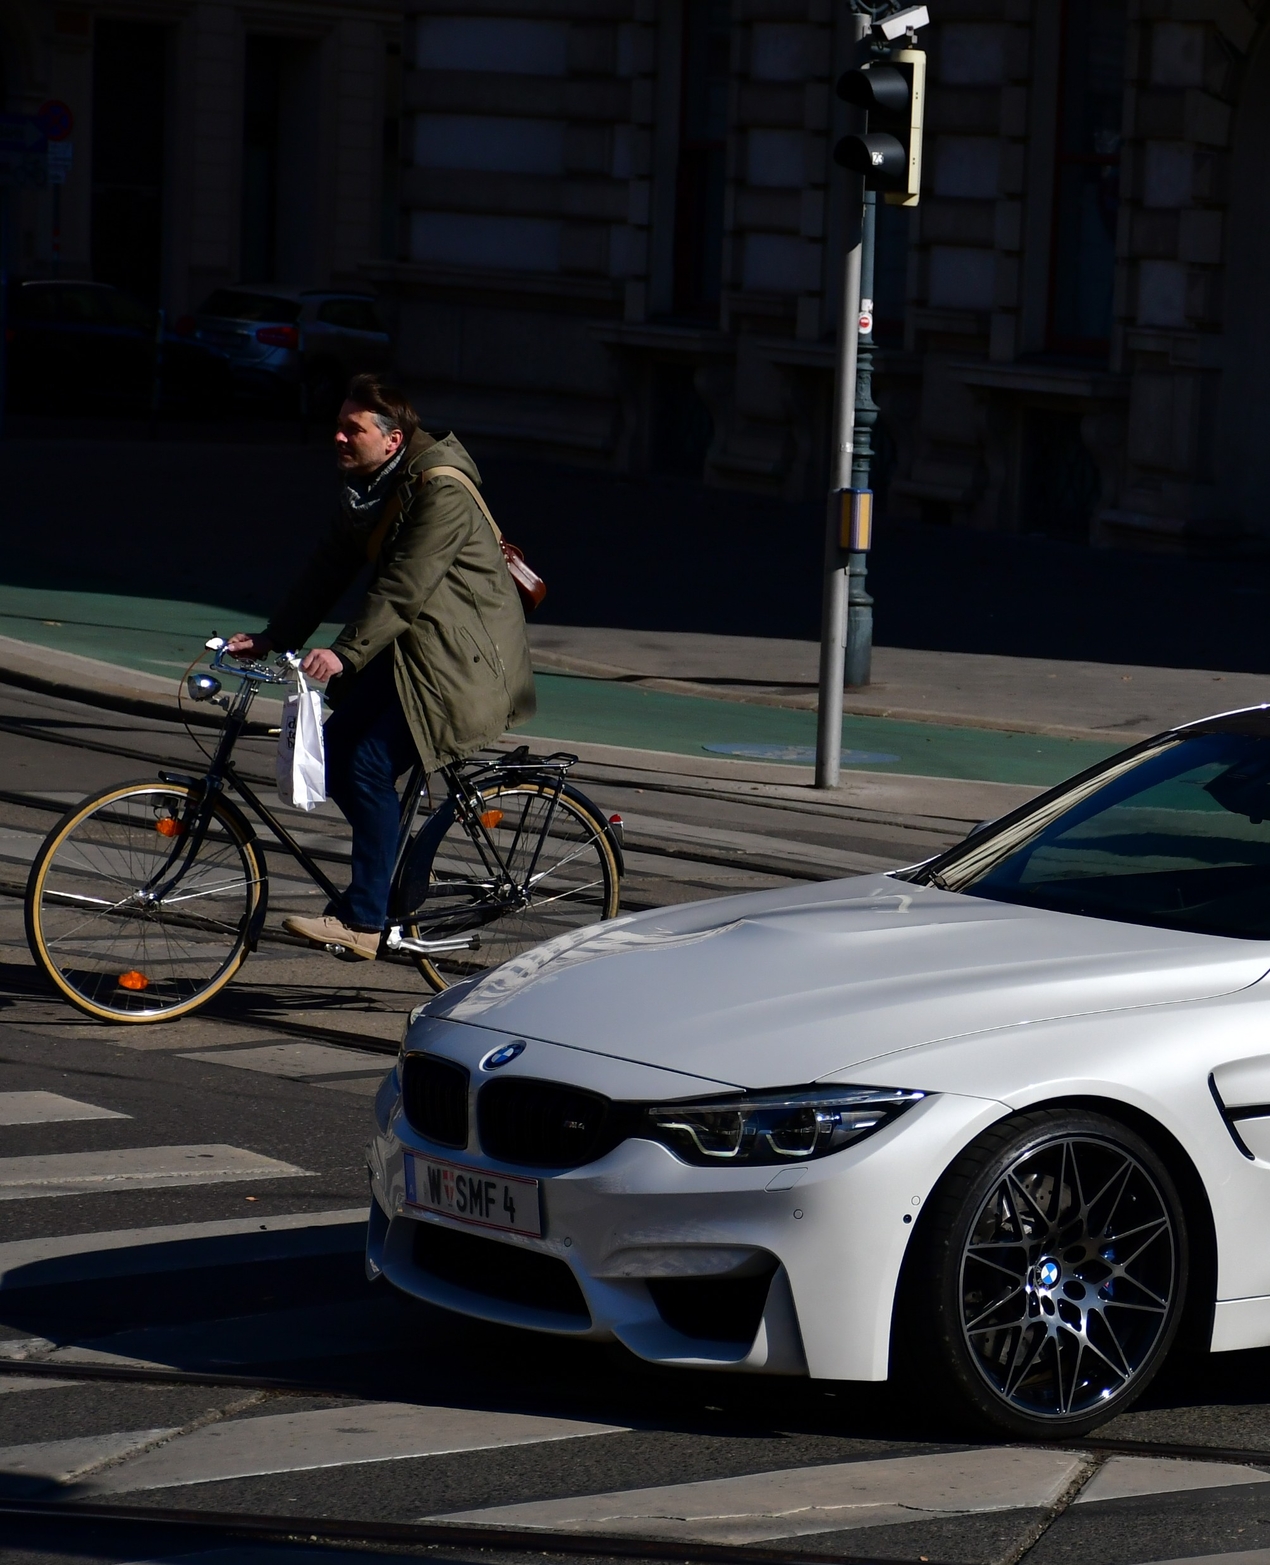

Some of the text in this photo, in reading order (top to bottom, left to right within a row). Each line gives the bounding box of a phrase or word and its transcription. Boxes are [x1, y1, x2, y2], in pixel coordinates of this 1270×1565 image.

[427, 1165, 516, 1224] W SMF 4
